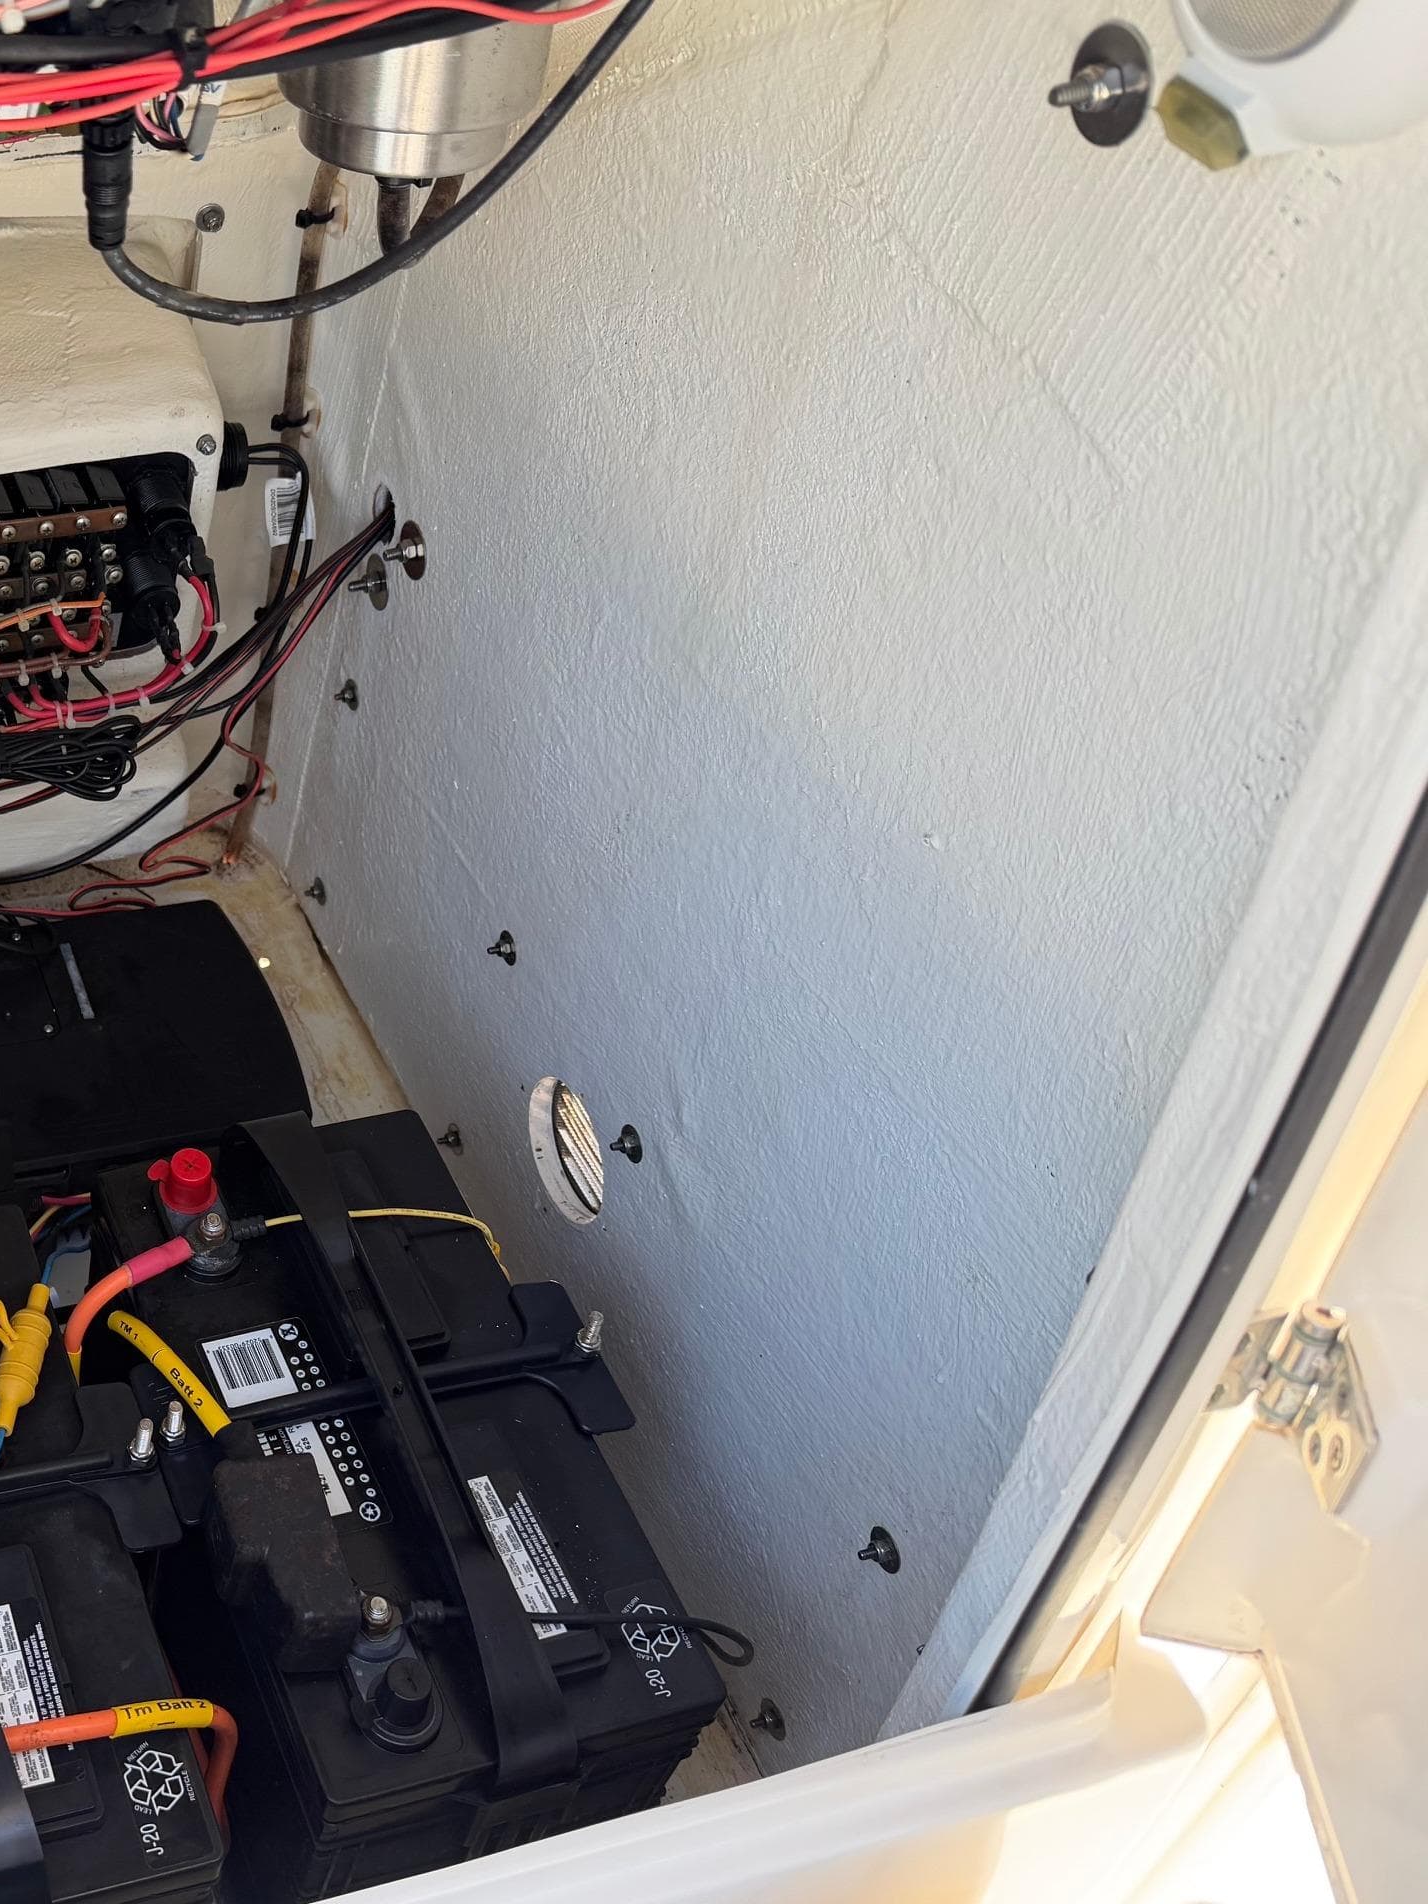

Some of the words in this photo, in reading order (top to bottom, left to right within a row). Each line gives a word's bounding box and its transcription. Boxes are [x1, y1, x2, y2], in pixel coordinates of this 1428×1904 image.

[119, 1320, 133, 1334] TM
[133, 1333, 139, 1341] 1
[169, 1367, 195, 1398] Batt
[193, 1397, 204, 1409] 2
[301, 1436, 312, 1450] 625
[620, 1594, 640, 1615] RETURN
[636, 1652, 654, 1662] LEAD
[31, 1668, 38, 1676] OF
[33, 1676, 44, 1695] REACH
[644, 1668, 672, 1697] J-20
[37, 1695, 47, 1705] THE
[45, 1692, 53, 1700] LA
[40, 1706, 49, 1714] OF
[121, 1705, 153, 1720] Tm
[156, 1699, 195, 1712] Batt
[196, 1700, 207, 1709] 2
[126, 1740, 150, 1762] RETURN
[181, 1770, 196, 1801] RECYCLE
[133, 1804, 153, 1815] LEAD
[139, 1823, 164, 1856] J-20
